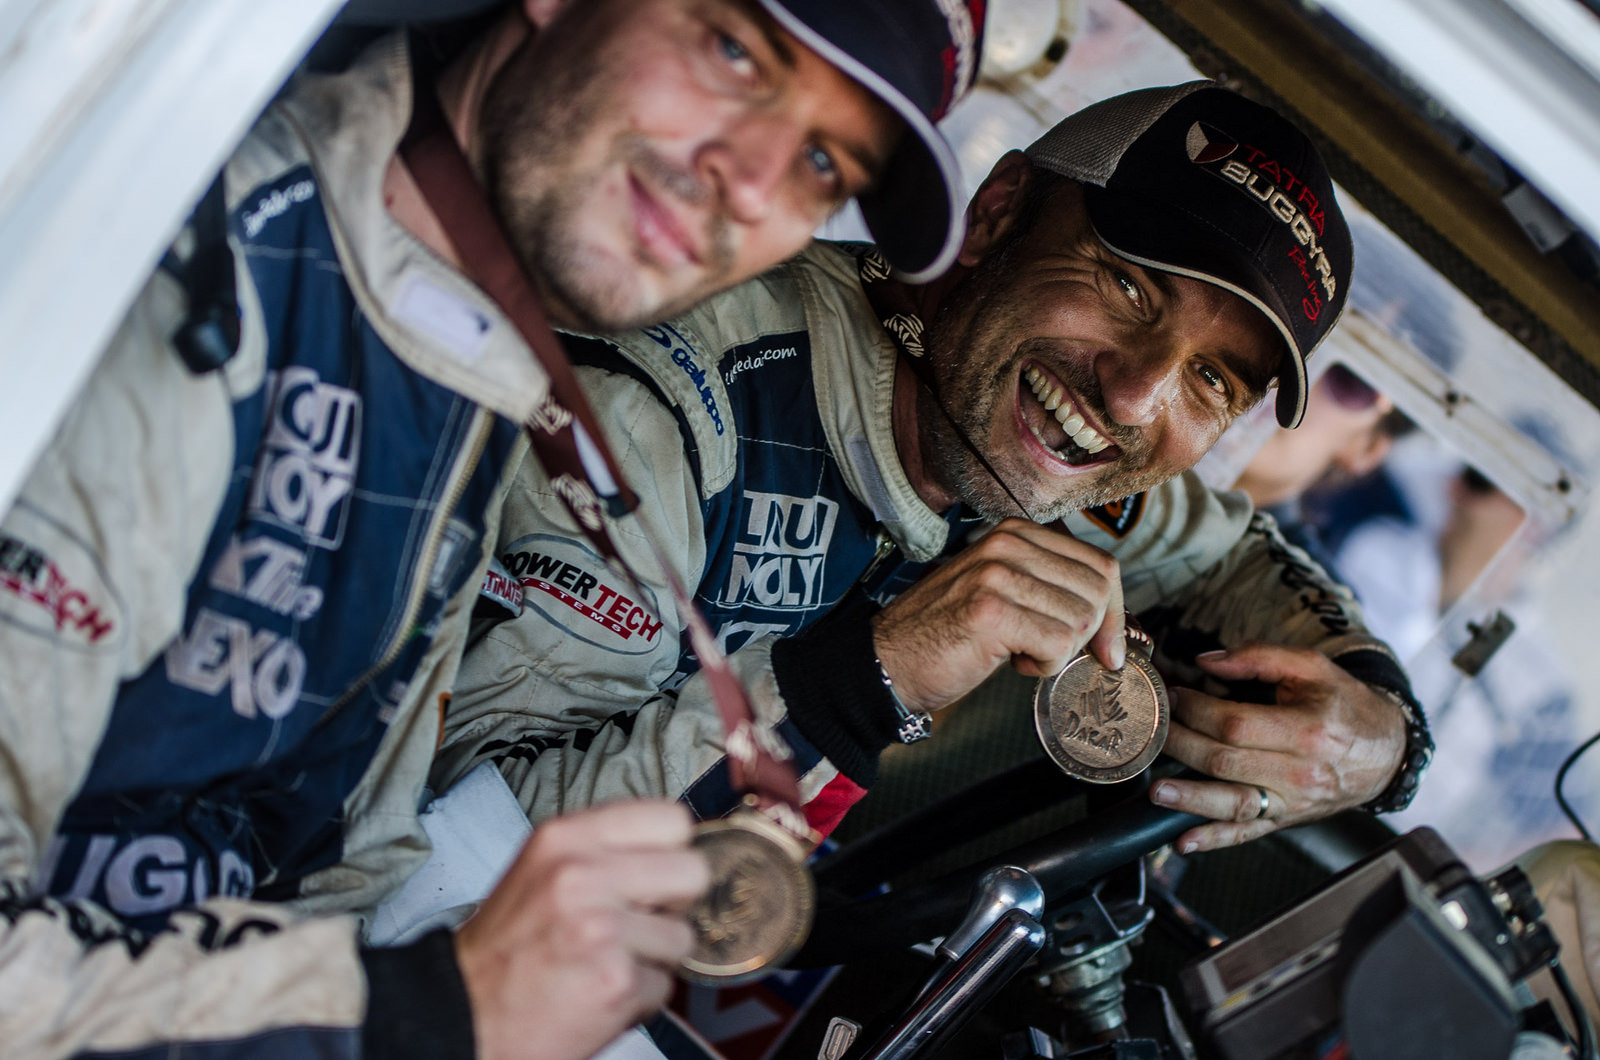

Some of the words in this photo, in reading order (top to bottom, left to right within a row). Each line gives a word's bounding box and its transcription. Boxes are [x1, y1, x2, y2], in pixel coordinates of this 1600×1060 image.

[1220, 159, 1337, 302] BUGGYRA
[1245, 144, 1325, 237] TATRA
[1288, 244, 1323, 325] Racing
[503, 550, 664, 642] POWERTECH
[520, 576, 624, 634] YSTEMS
[725, 552, 824, 606] MOLY
[1062, 710, 1124, 760] DAKAR
